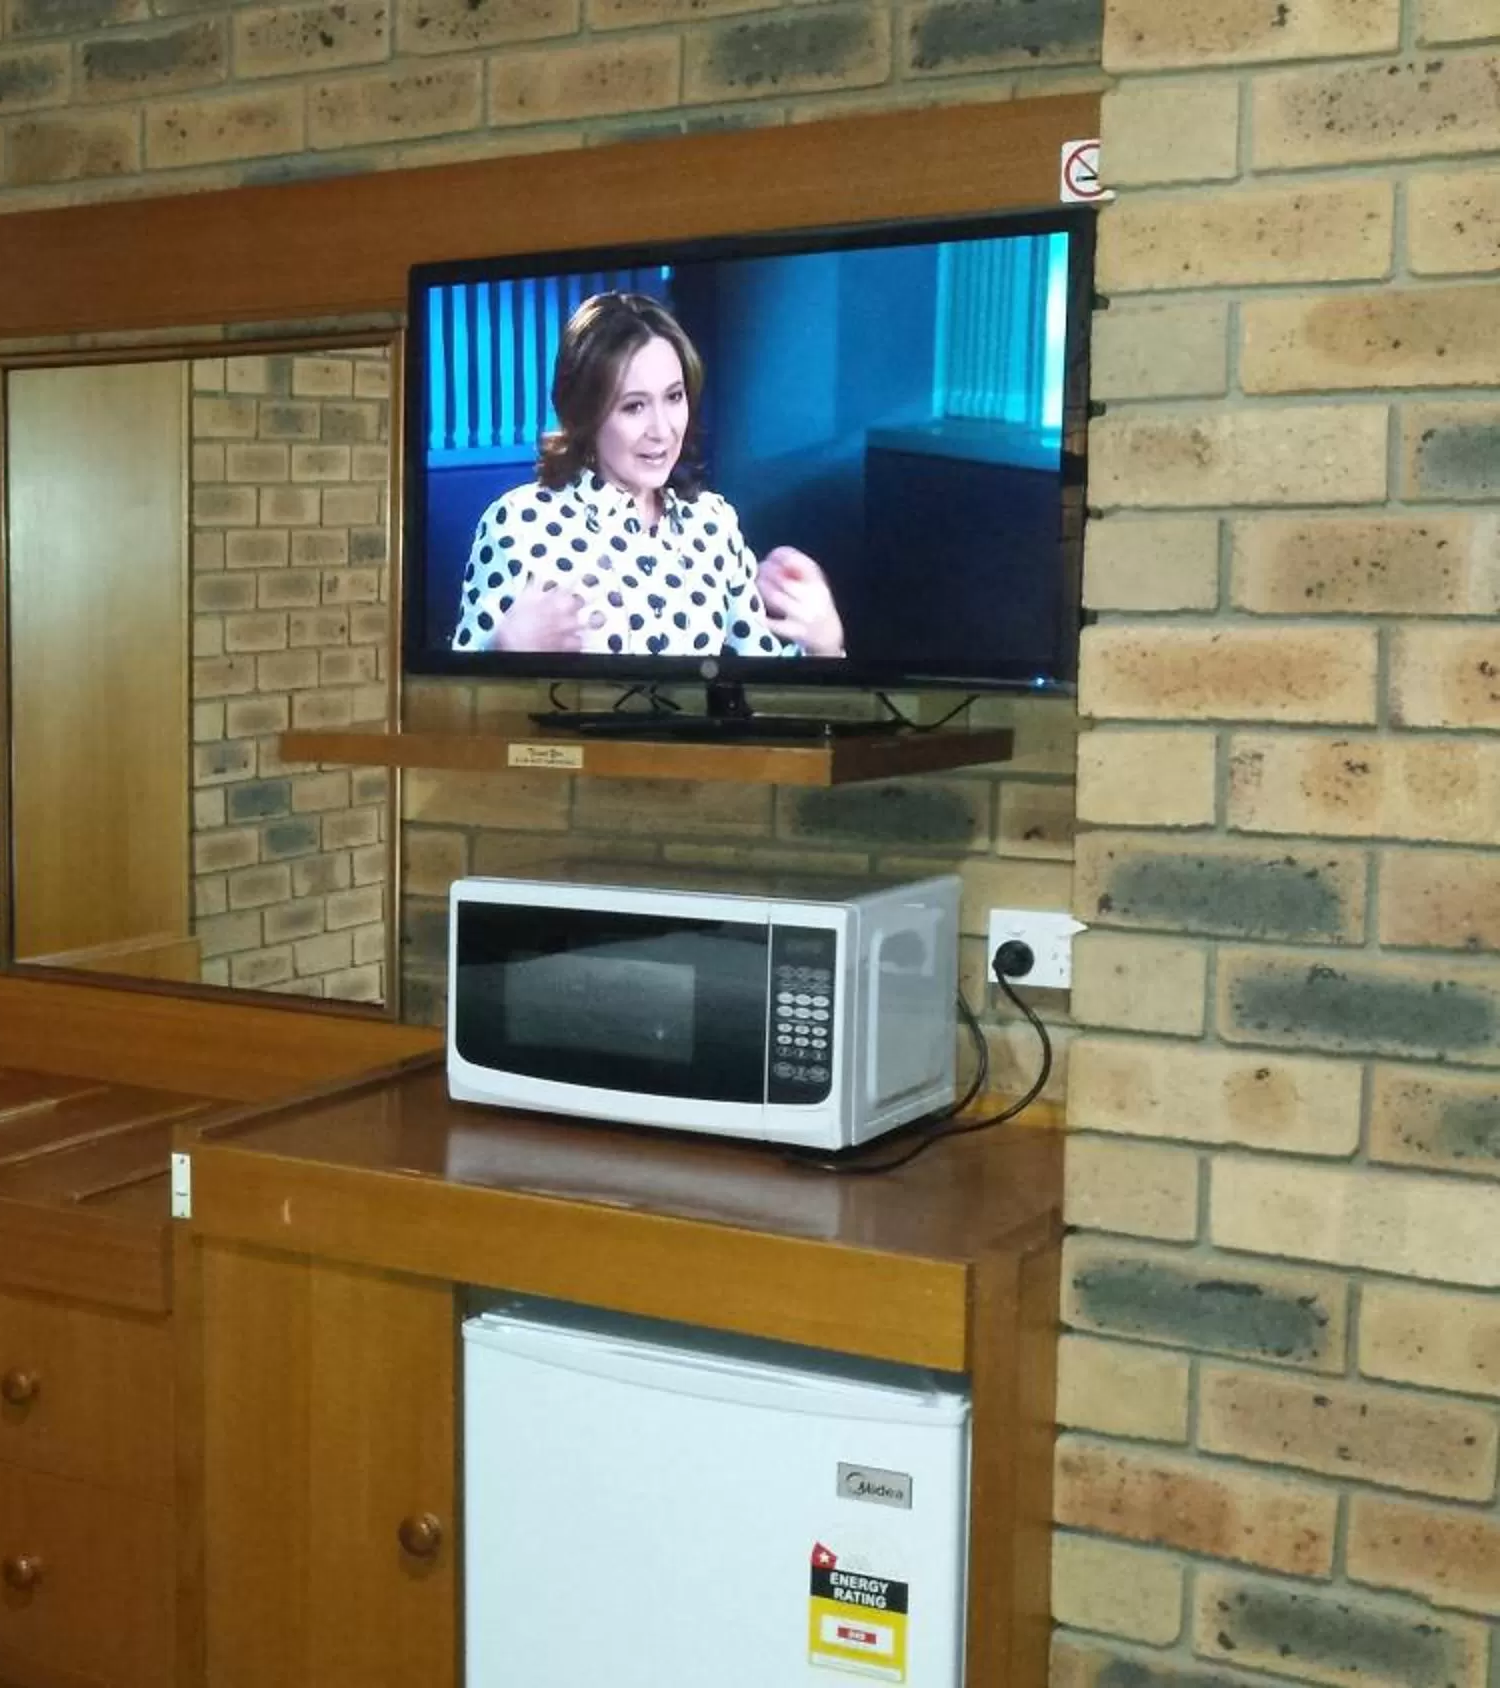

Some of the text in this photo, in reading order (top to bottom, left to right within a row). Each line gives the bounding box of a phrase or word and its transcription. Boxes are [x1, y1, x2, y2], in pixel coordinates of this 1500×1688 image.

[853, 1478, 904, 1500] Midea
[830, 1571, 889, 1594] ENERGY
[833, 1587, 887, 1609] RATING
